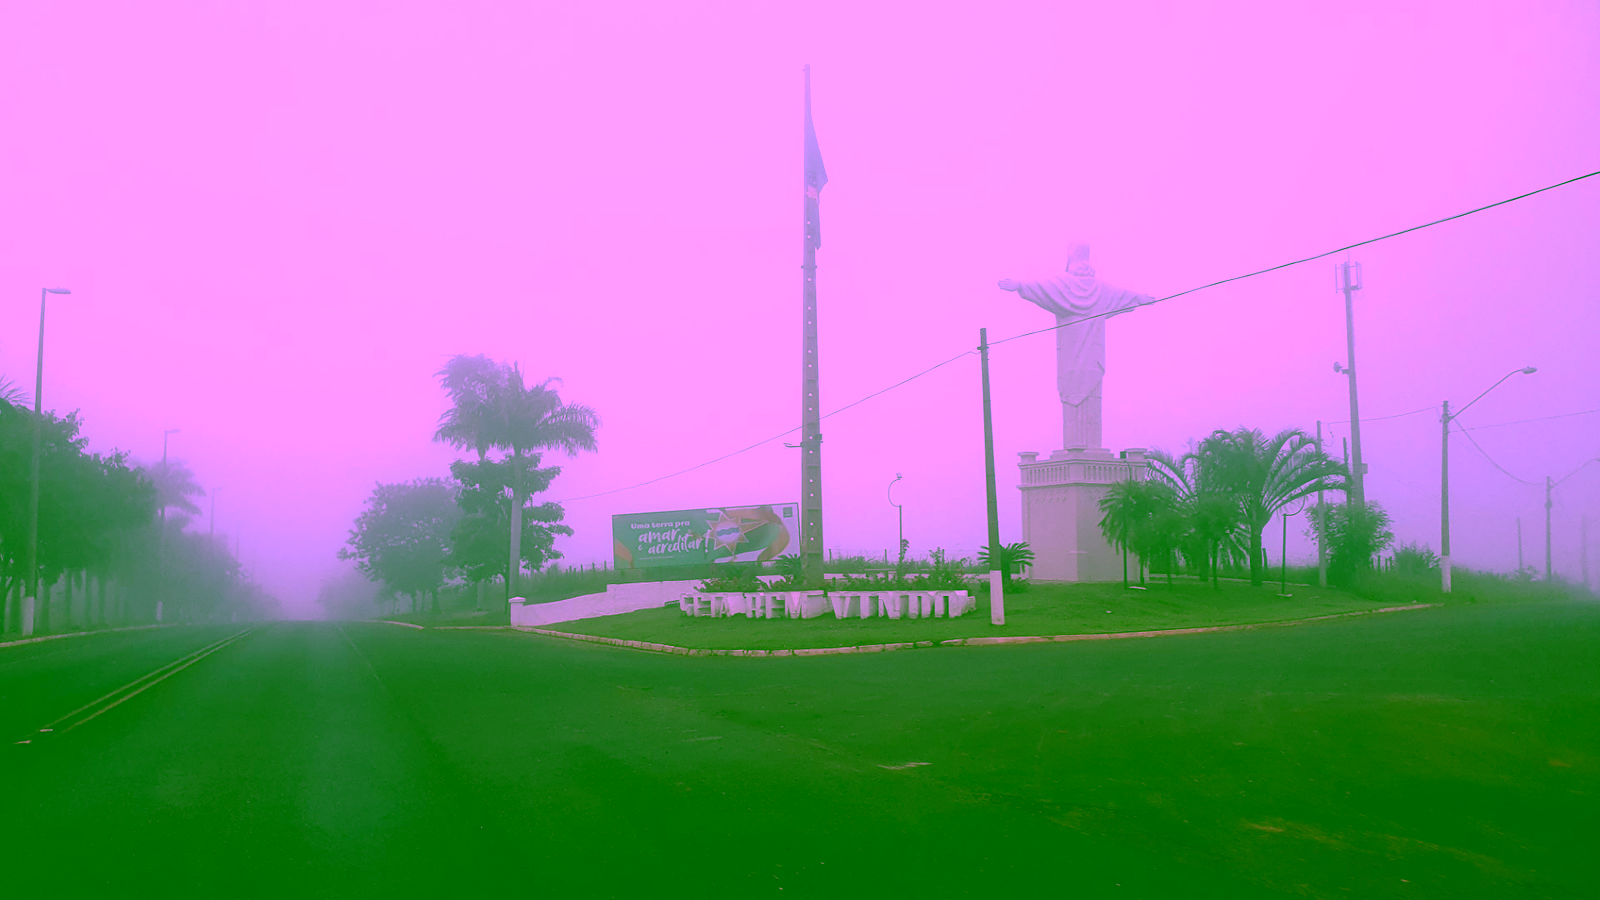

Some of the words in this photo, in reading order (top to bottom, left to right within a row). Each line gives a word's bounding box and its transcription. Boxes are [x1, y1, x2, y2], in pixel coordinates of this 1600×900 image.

[675, 520, 690, 528] pra
[638, 528, 681, 544] amar
[648, 529, 711, 554] acreditar!
